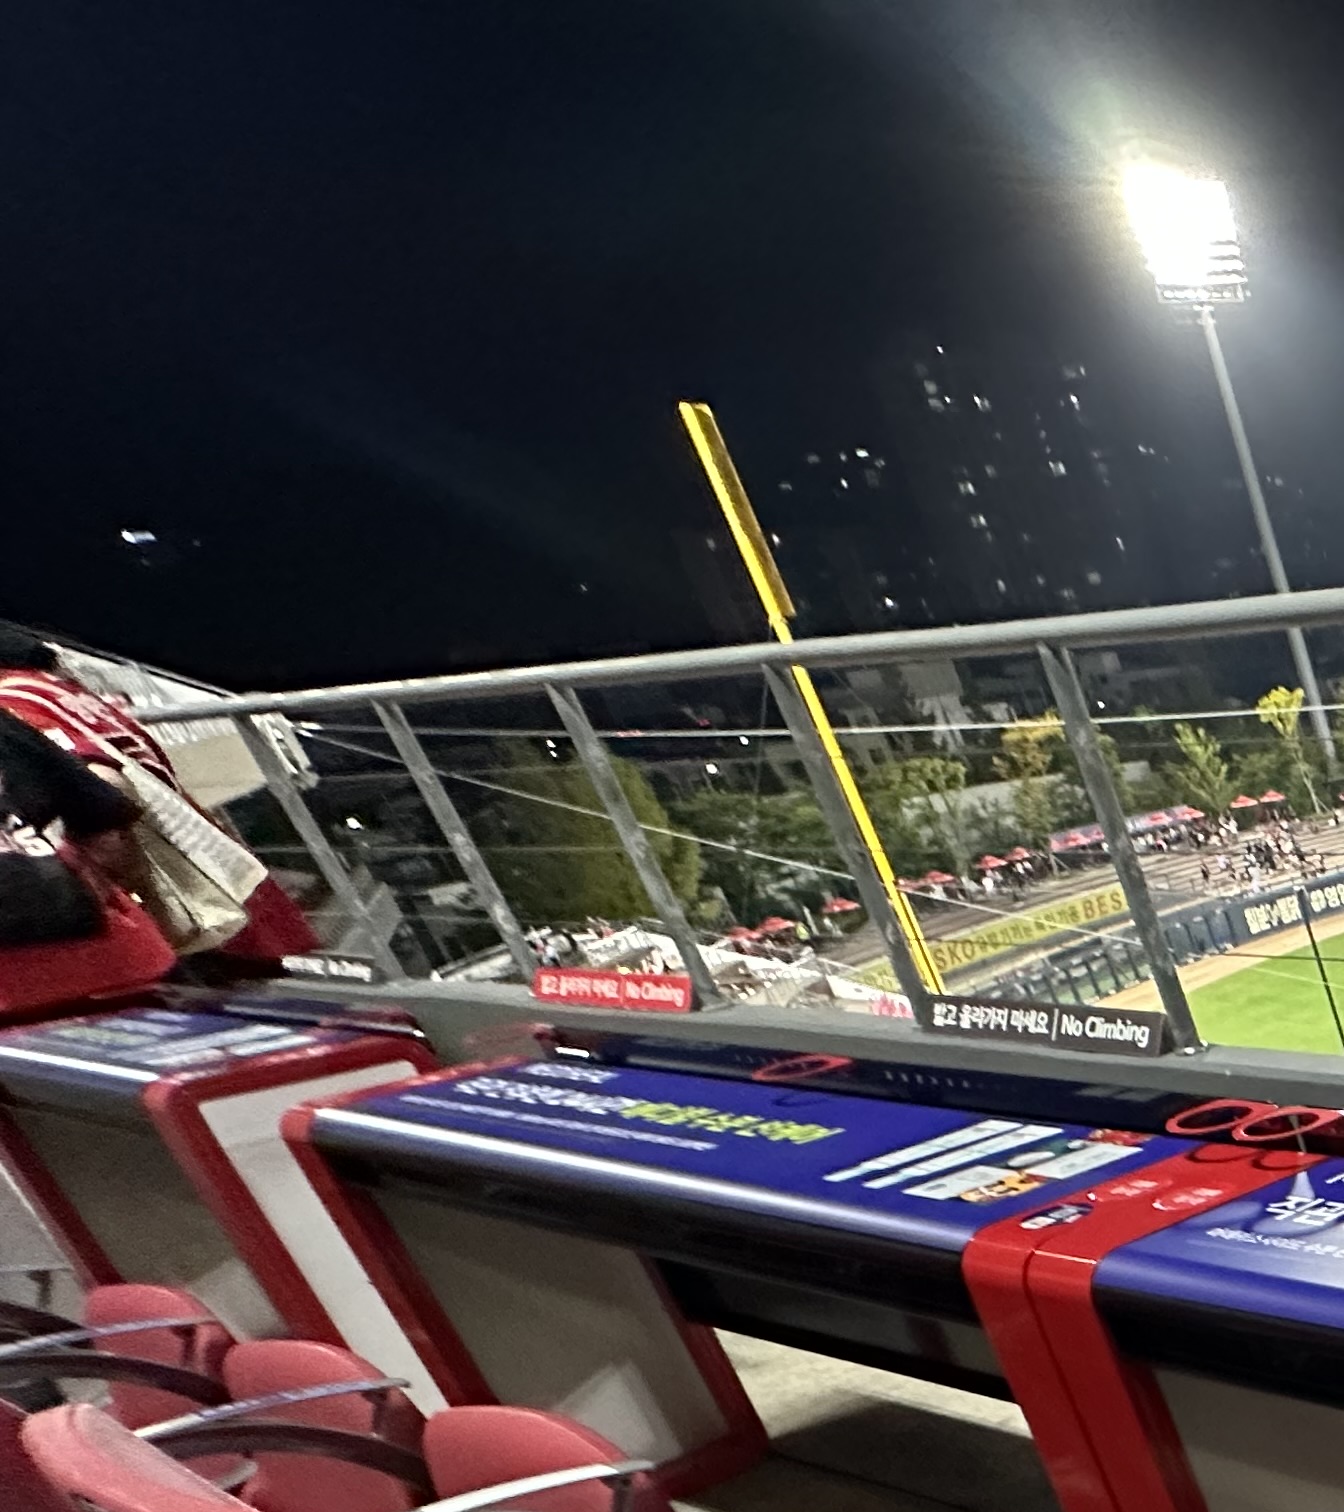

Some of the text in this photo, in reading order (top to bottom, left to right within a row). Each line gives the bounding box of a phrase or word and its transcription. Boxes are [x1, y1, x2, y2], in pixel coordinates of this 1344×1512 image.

[1082, 891, 1124, 920] BES
[1060, 1013, 1083, 1037] No
[1084, 1015, 1150, 1049] Climbing
